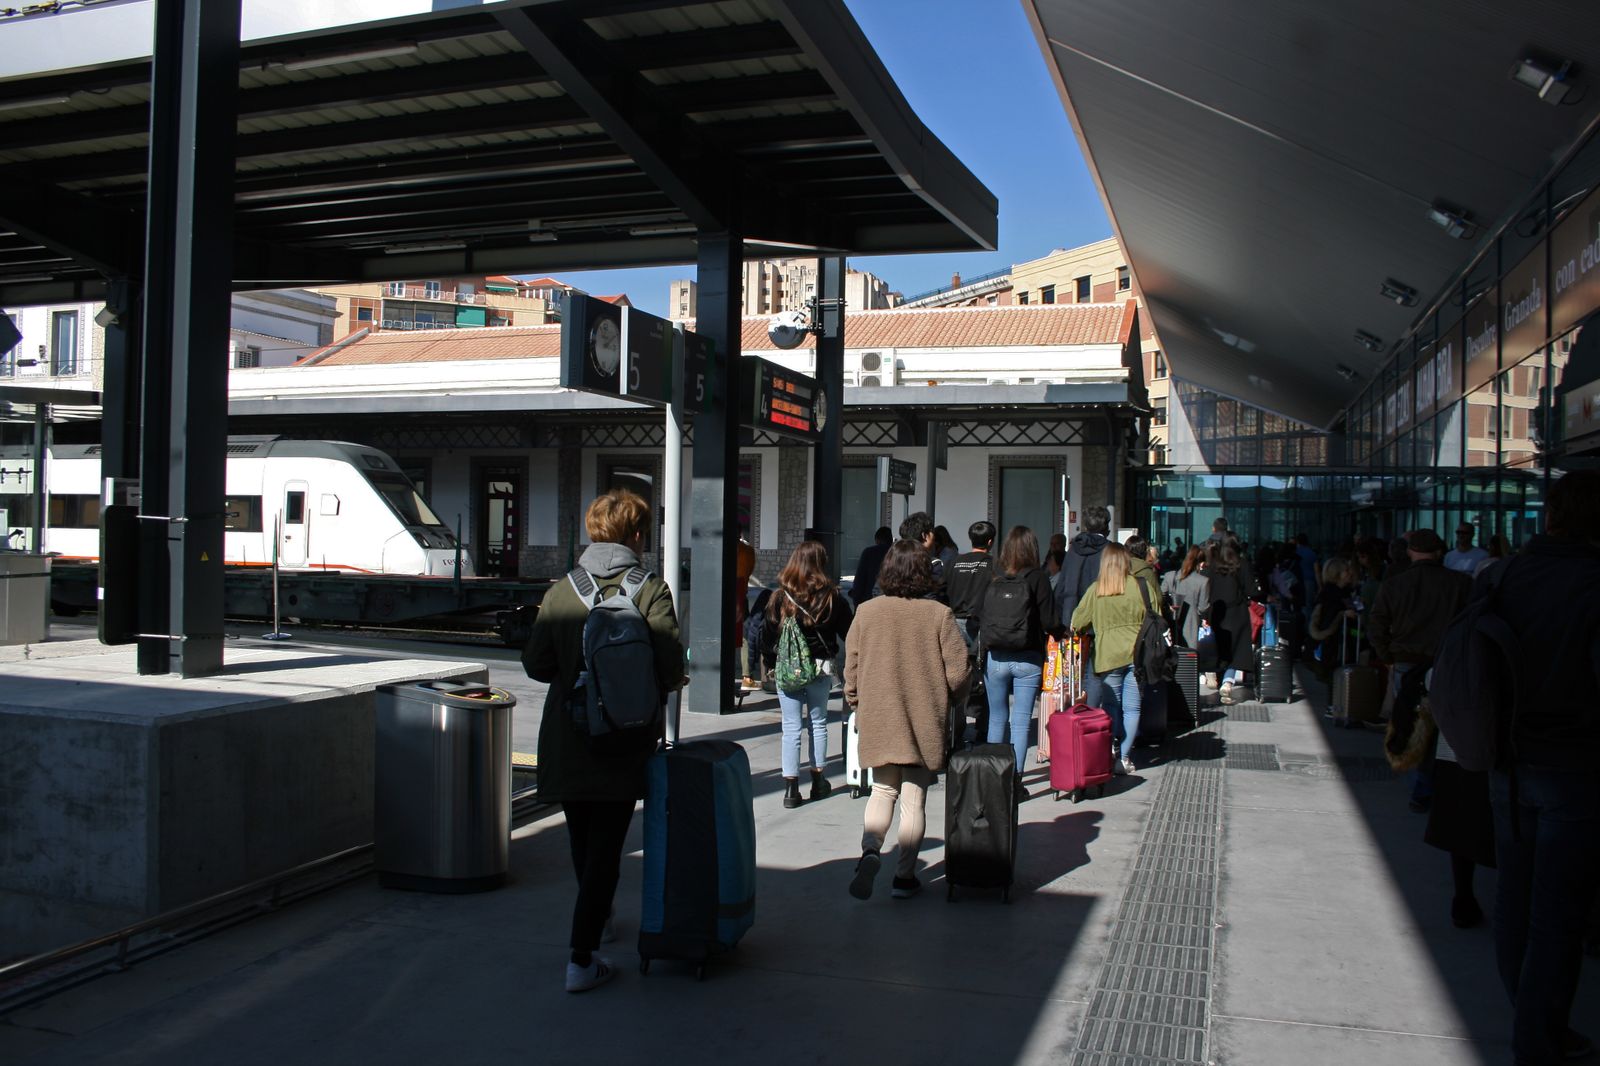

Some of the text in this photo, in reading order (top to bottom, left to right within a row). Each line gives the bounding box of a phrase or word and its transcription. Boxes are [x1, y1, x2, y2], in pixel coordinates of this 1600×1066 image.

[1466, 320, 1497, 363] Descubre
[1504, 278, 1541, 332] Granada
[1555, 259, 1576, 293] con
[630, 351, 640, 391] 5
[695, 374, 705, 402] 5
[761, 393, 768, 419] 4
